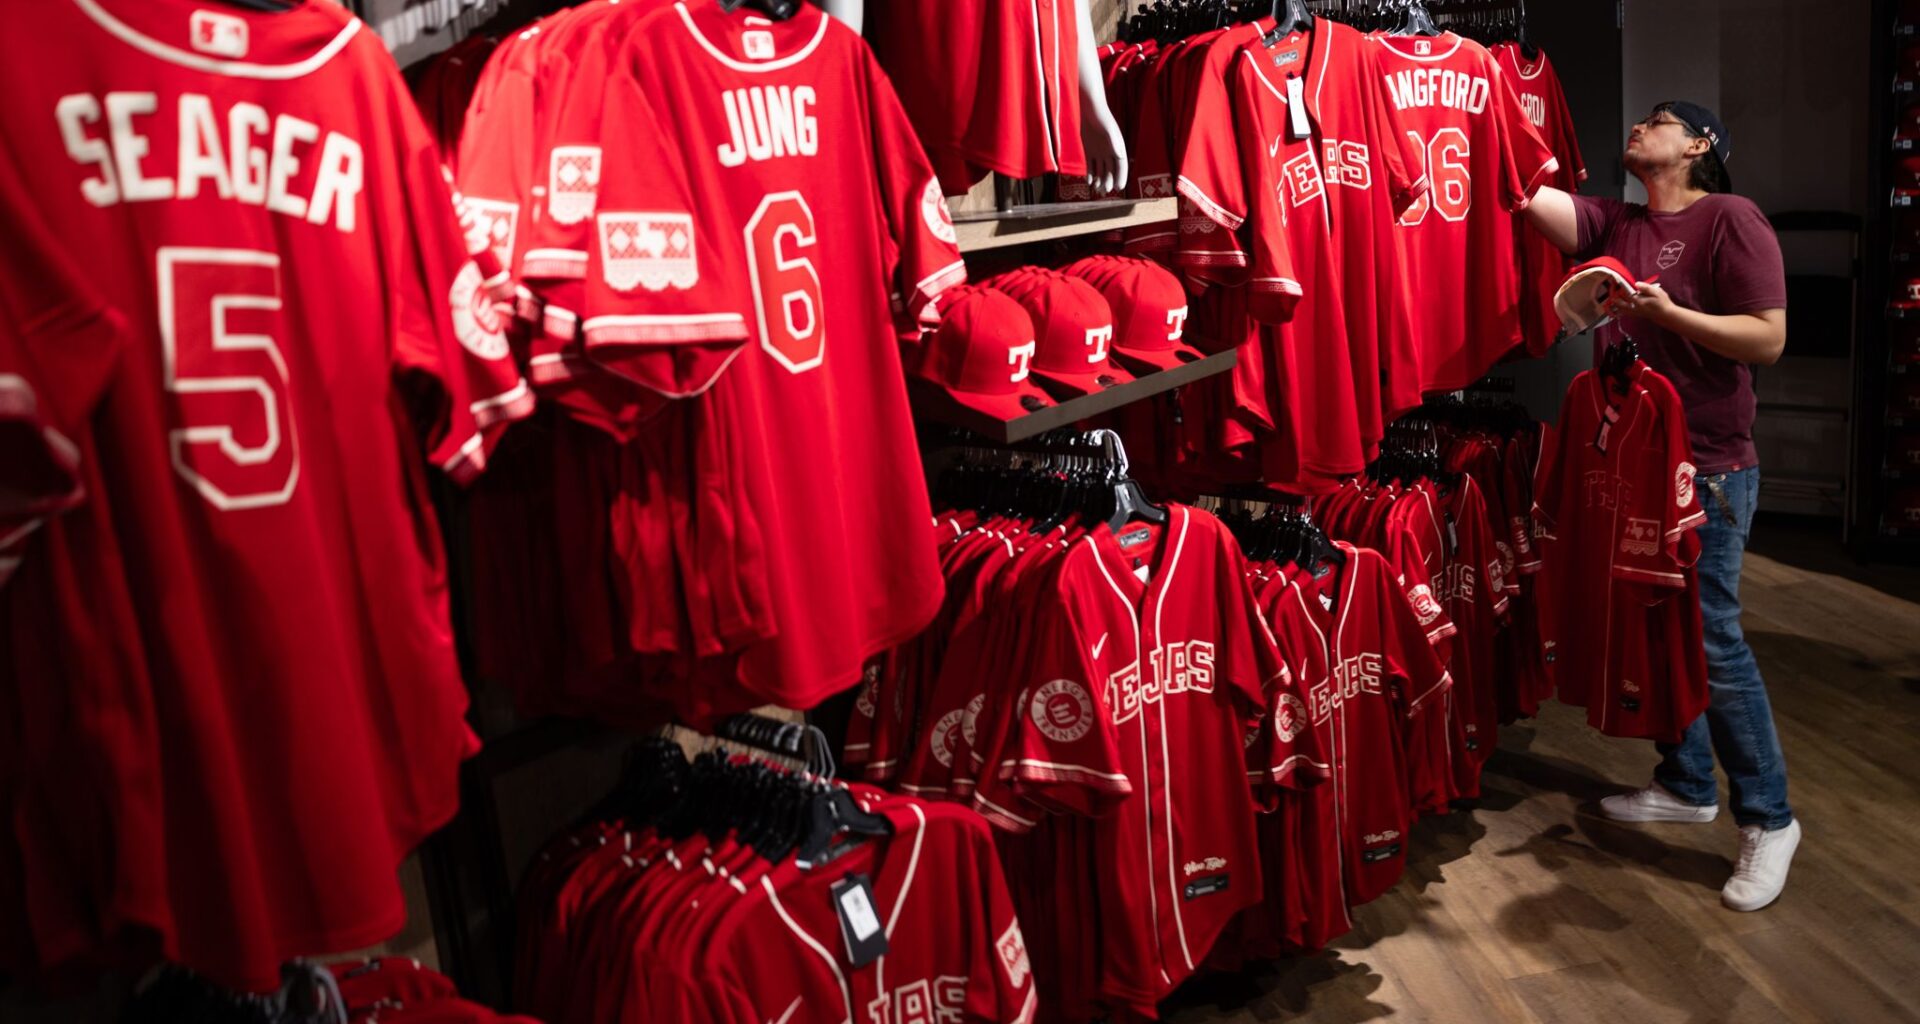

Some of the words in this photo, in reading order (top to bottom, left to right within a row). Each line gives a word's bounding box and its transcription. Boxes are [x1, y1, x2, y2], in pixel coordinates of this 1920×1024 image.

[55, 92, 363, 233] SEAGER
[717, 85, 818, 167] JUNG
[743, 190, 824, 374] 6
[1085, 324, 1112, 364] T
[1167, 305, 1189, 341] T
[157, 246, 299, 511] 5
[1008, 339, 1036, 383] T
[1035, 680, 1089, 705] ENERGY
[1105, 639, 1215, 725] EJAS
[1309, 652, 1382, 727] EJAS
[1035, 712, 1092, 740] TRANSFER
